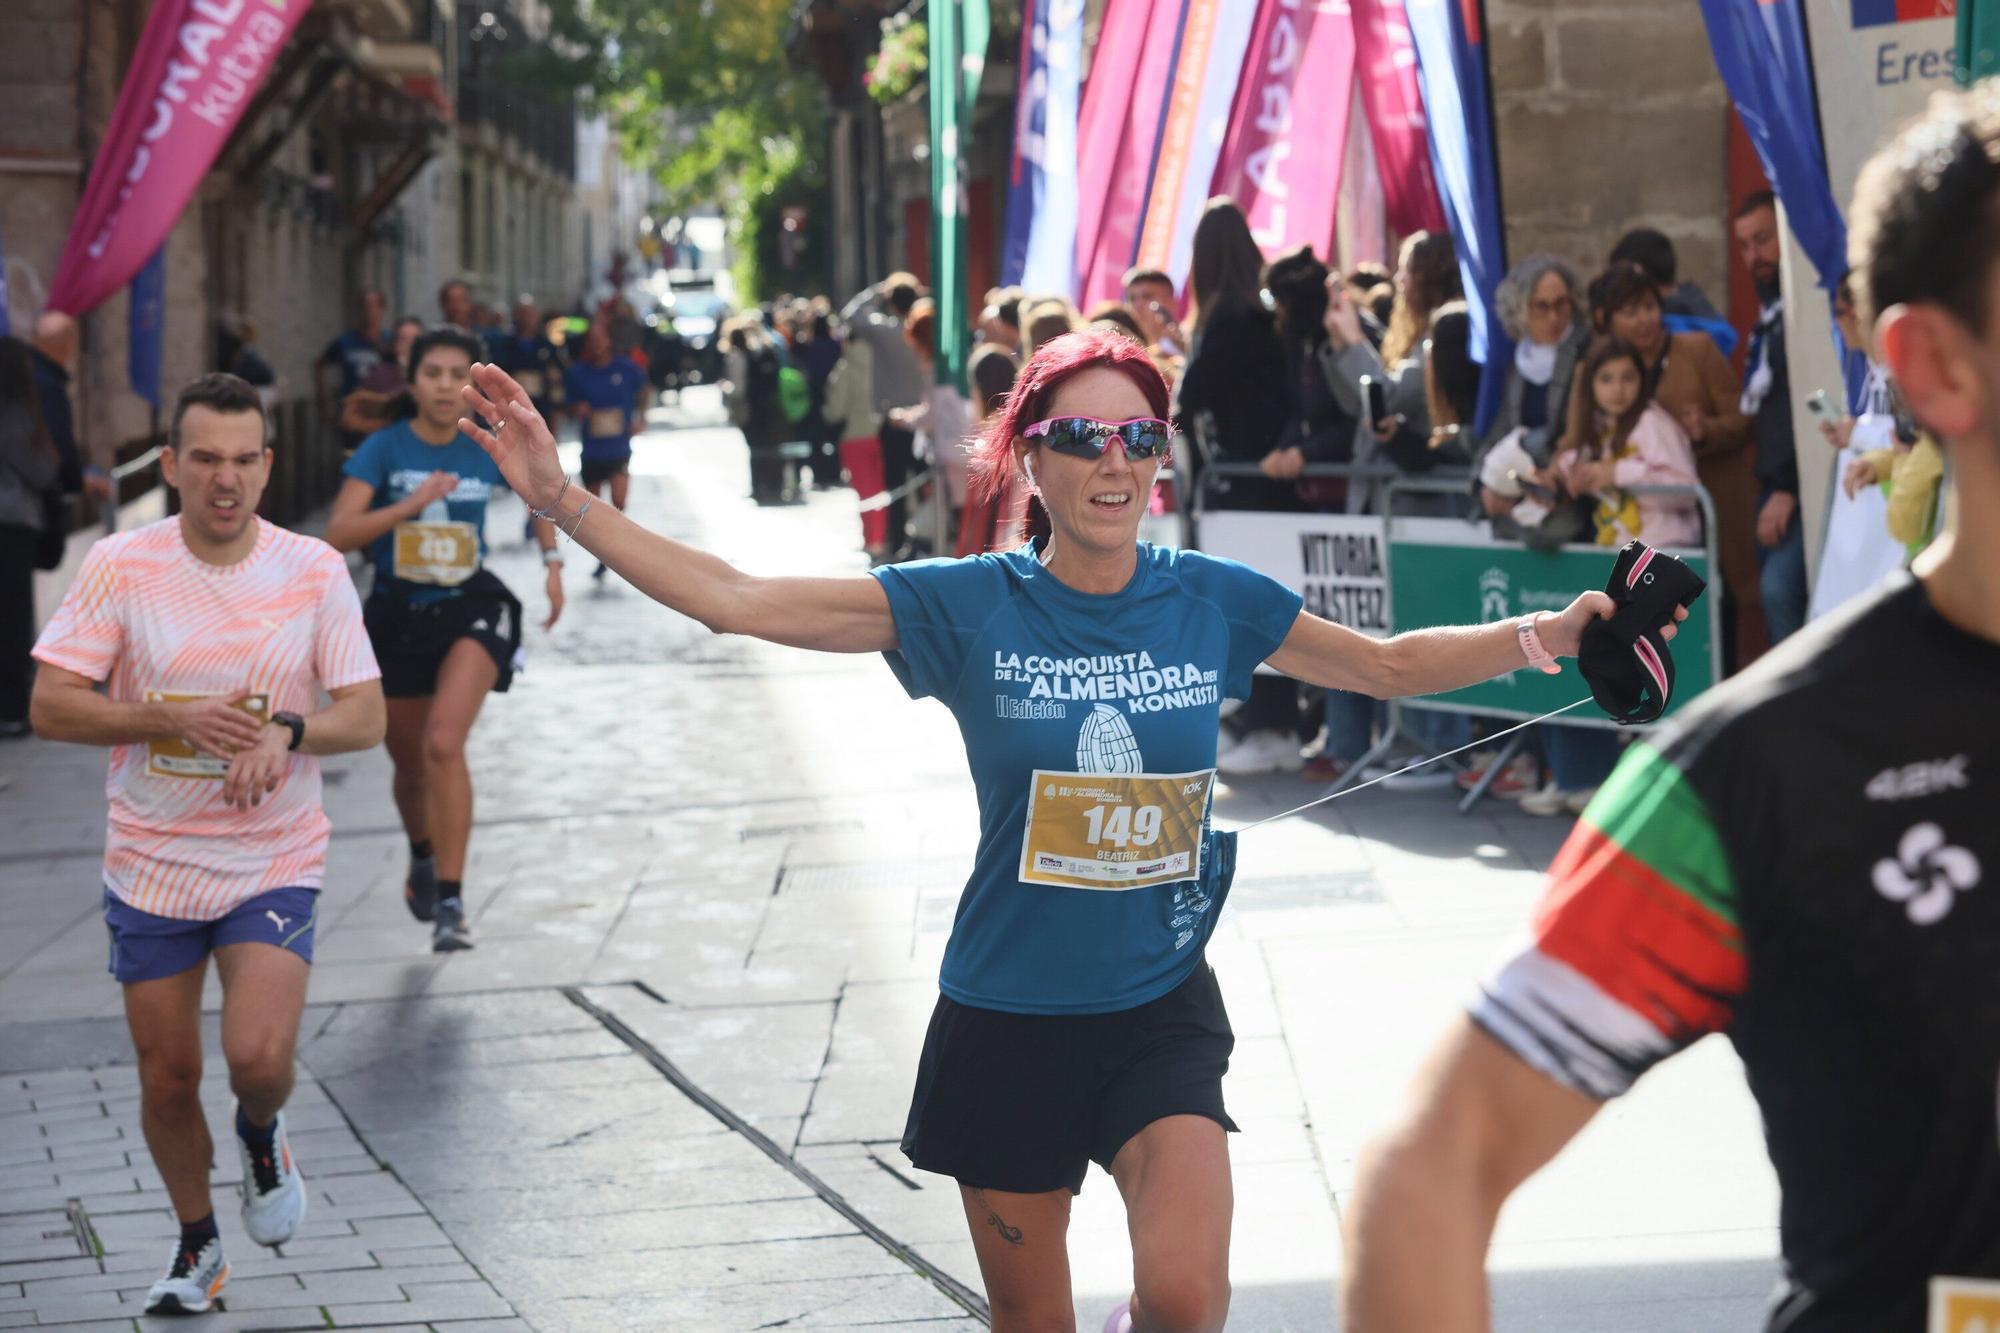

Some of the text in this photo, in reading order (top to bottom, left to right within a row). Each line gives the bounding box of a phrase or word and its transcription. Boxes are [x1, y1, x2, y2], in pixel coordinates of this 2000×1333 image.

[189, 10, 286, 128] kutxa
[1299, 533, 1383, 577] VITORIA
[1304, 584, 1387, 629] GASTEIZ
[995, 650, 1155, 679] LA CONQUISTA
[995, 669, 1012, 681] DE
[1014, 671, 1032, 683] LA
[1028, 663, 1204, 701] ALMENDRA
[1009, 698, 1067, 720] Edición
[1128, 684, 1218, 714] KONKISTA
[1083, 805, 1162, 848] 149
[1096, 850, 1140, 862] BEATRIZ
